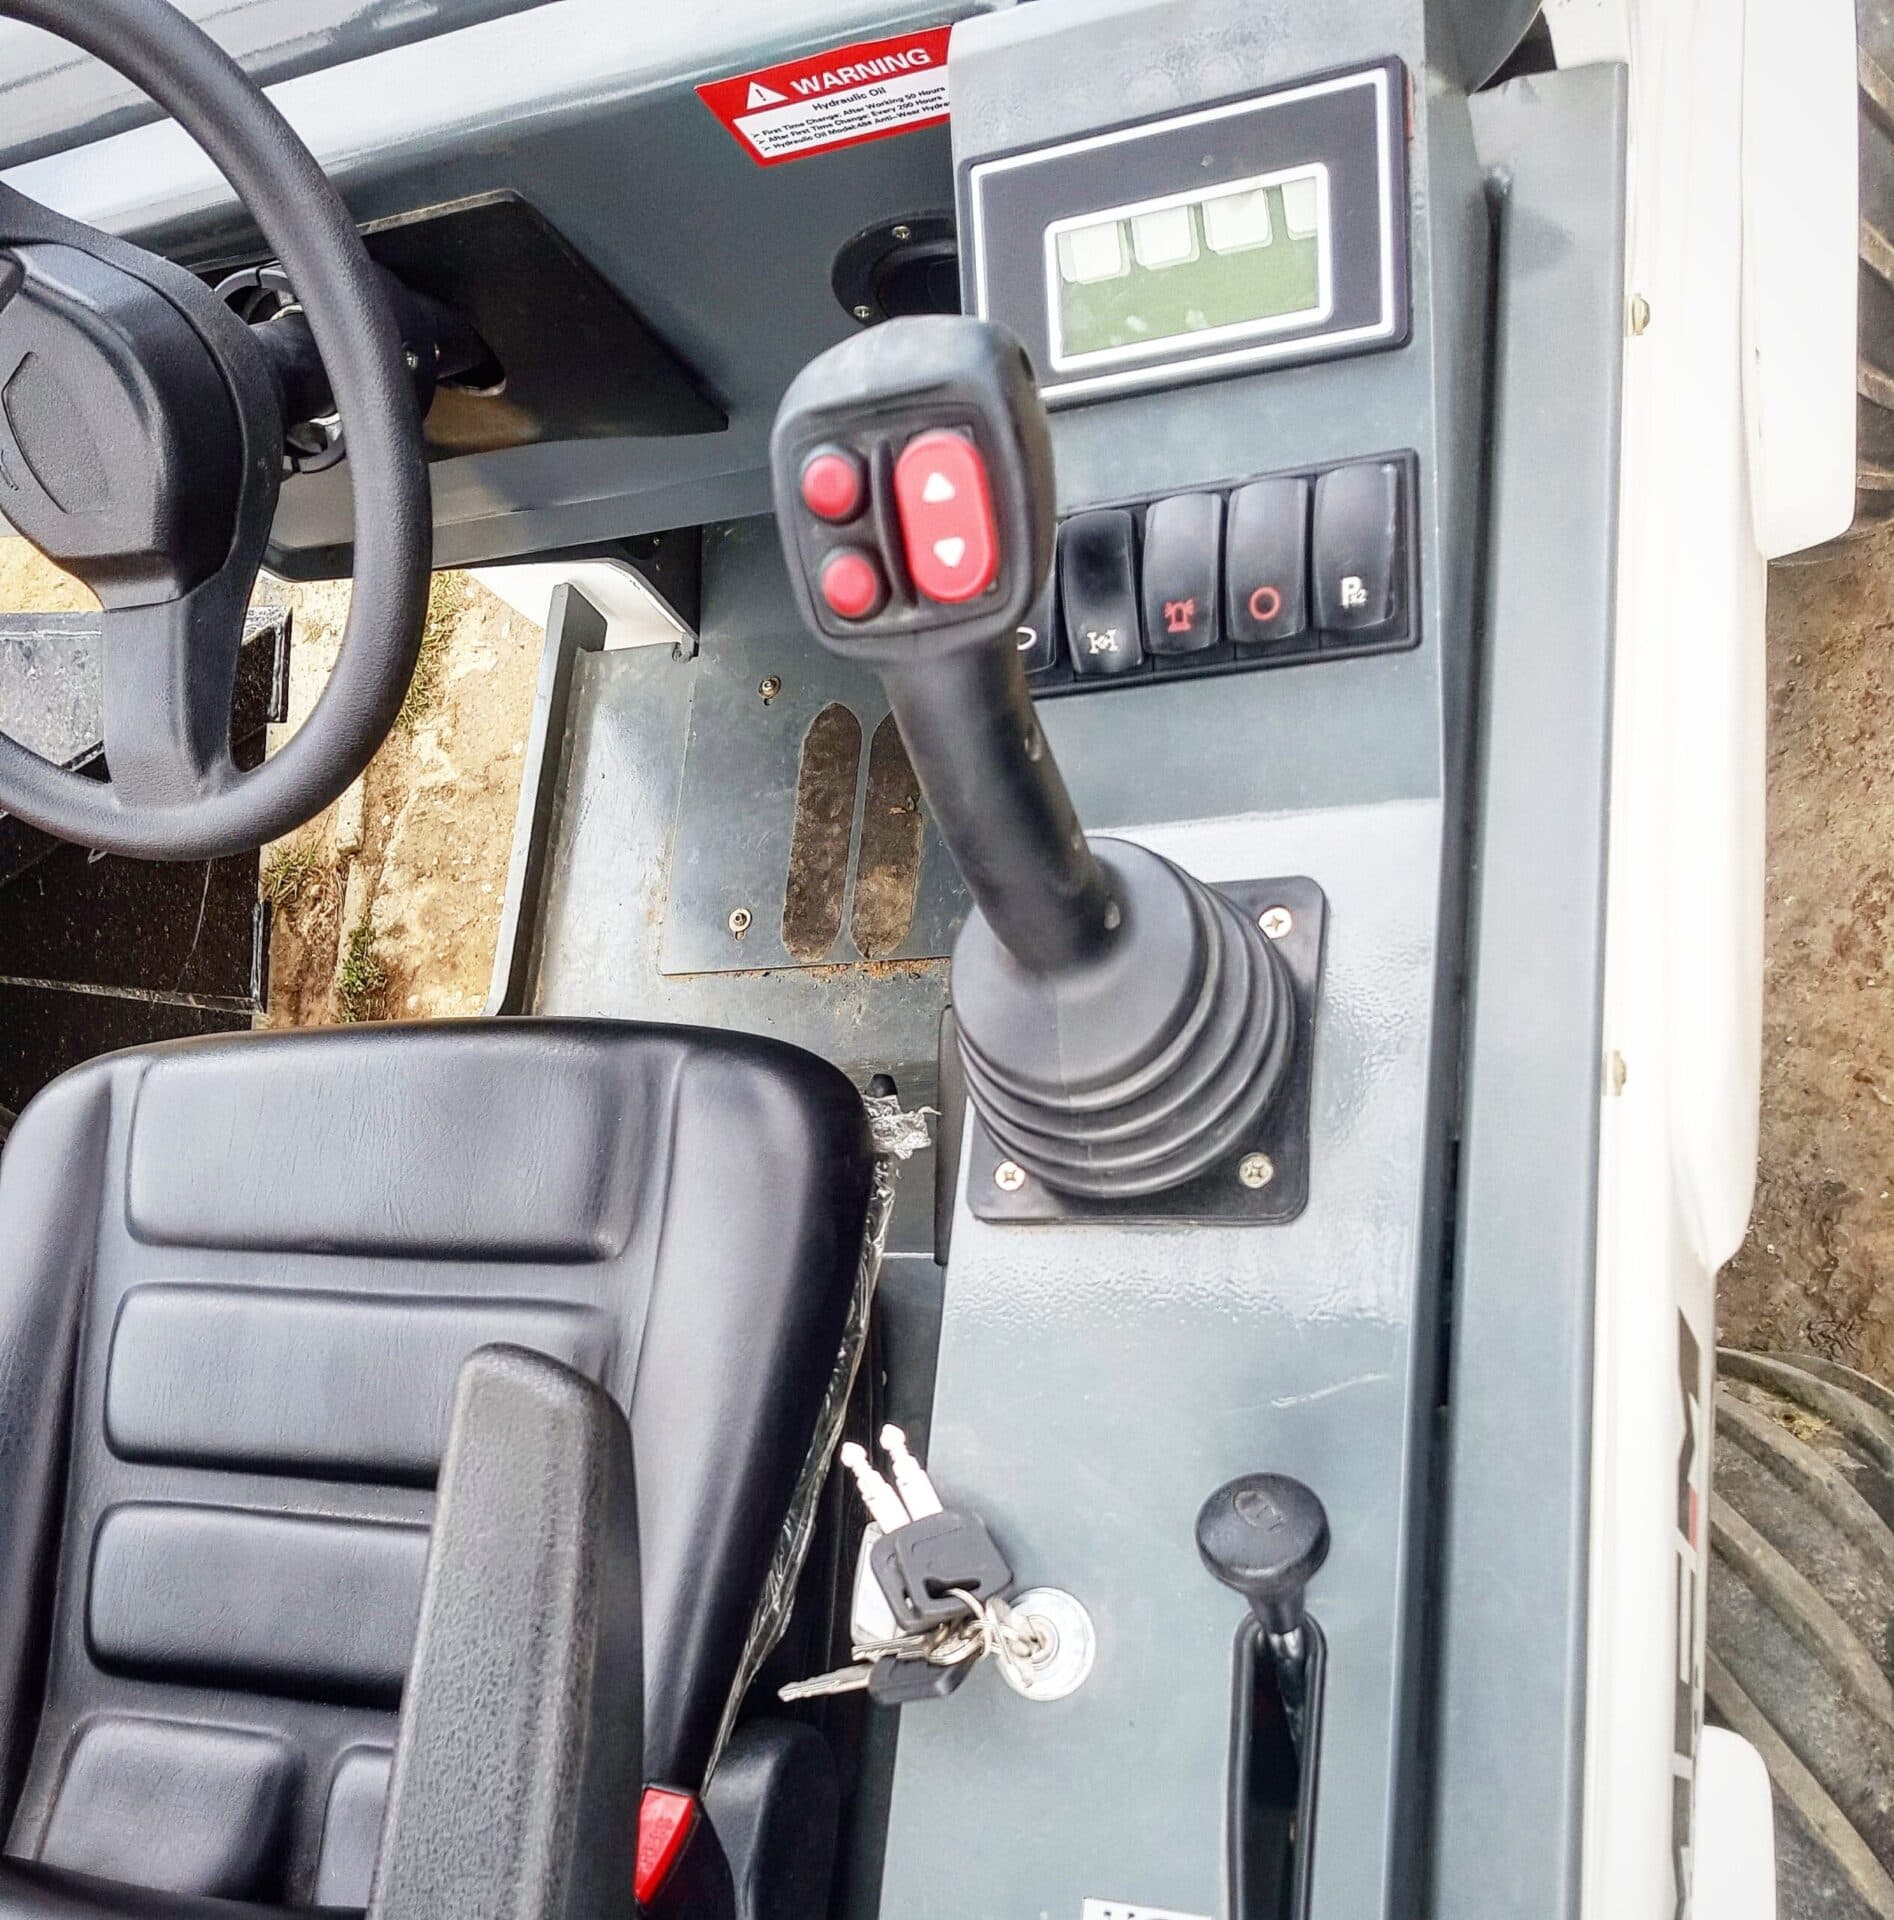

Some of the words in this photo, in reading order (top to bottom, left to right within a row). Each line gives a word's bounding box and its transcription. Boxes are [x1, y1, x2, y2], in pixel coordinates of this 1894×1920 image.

[790, 48, 931, 95] WARNING
[761, 128, 782, 136] First
[783, 122, 805, 130] Time
[843, 107, 864, 116] After
[865, 97, 904, 109] Working
[918, 86, 946, 97] Hours
[768, 134, 789, 142] After
[790, 128, 810, 136] First
[810, 123, 834, 131] Time
[870, 106, 896, 117] Every
[897, 102, 914, 110] 200
[915, 95, 942, 105] Hours
[812, 92, 867, 111] Hydraulic
[869, 87, 886, 97] Oil
[773, 136, 814, 148] Hydraulic
[814, 131, 827, 139] Oil
